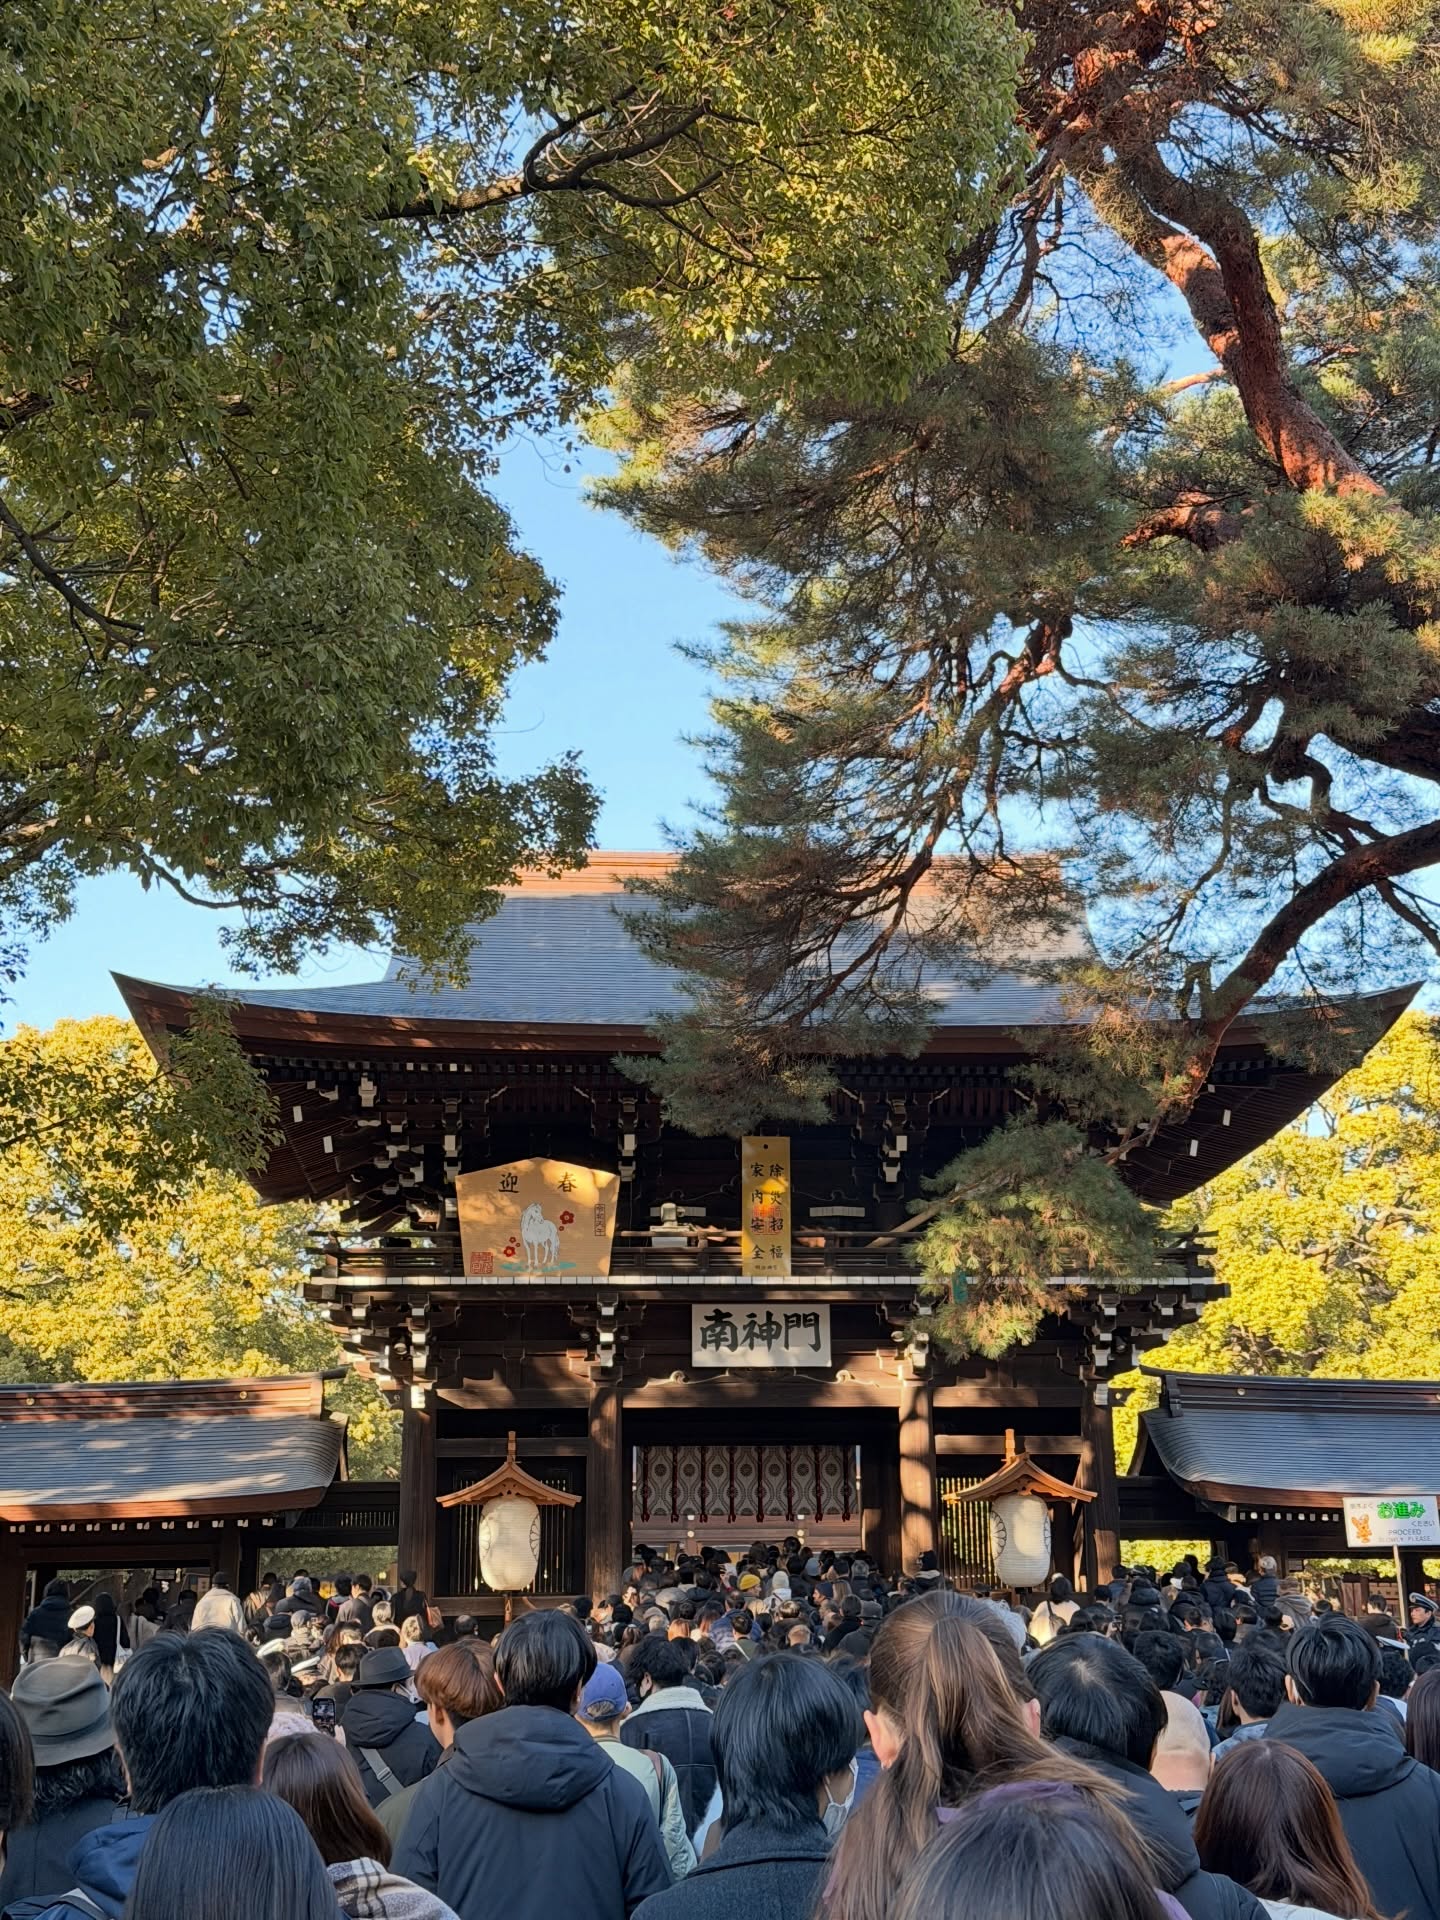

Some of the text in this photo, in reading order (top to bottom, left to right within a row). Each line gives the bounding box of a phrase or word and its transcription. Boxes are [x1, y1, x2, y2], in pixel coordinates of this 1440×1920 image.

[750, 1162, 765, 1260] 家内安全
[769, 1164, 784, 1259] 除災招福
[700, 1308, 821, 1352] 南神門
[1377, 1501, 1426, 1520] お進み
[1388, 1528, 1421, 1536] PROCEED
